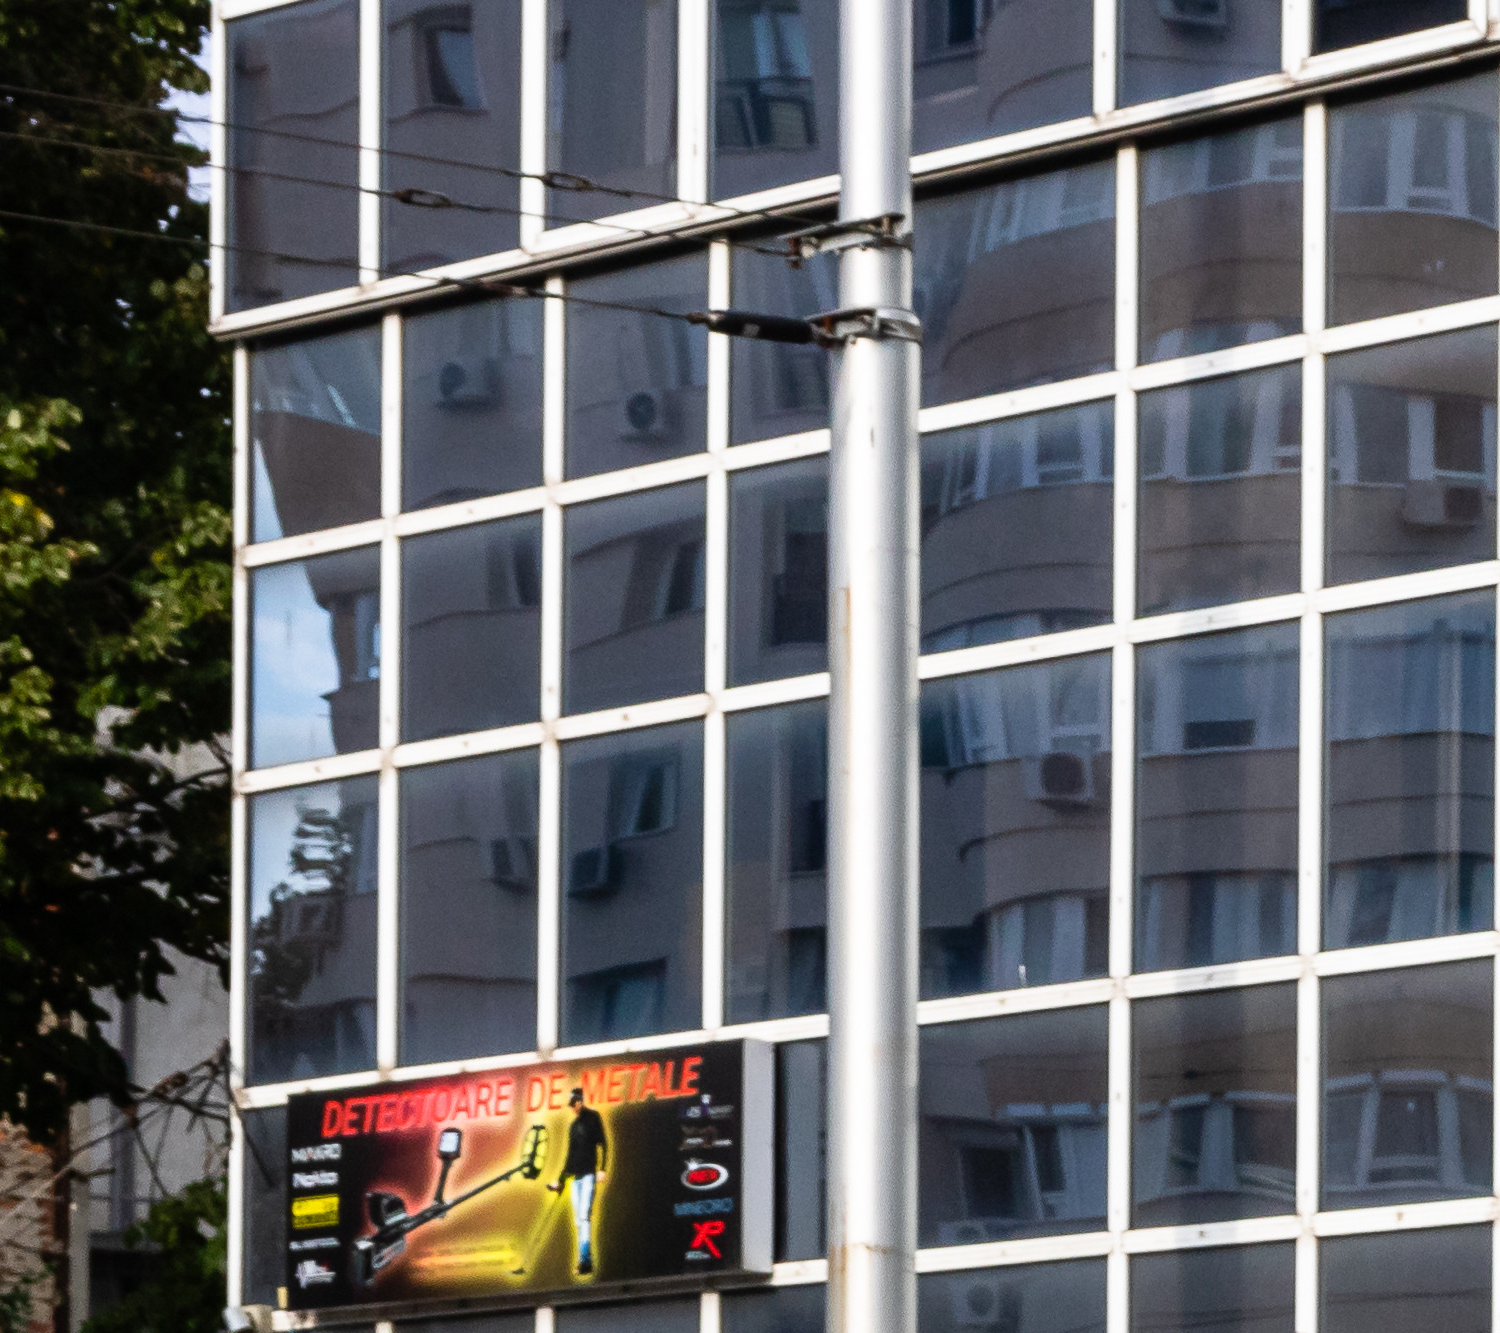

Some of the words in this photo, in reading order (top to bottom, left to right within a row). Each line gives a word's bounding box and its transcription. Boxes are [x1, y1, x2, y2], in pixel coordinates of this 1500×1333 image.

[321, 1078, 514, 1138] DETECTOARE
[525, 1074, 569, 1113] DE
[580, 1056, 703, 1108] METALE
